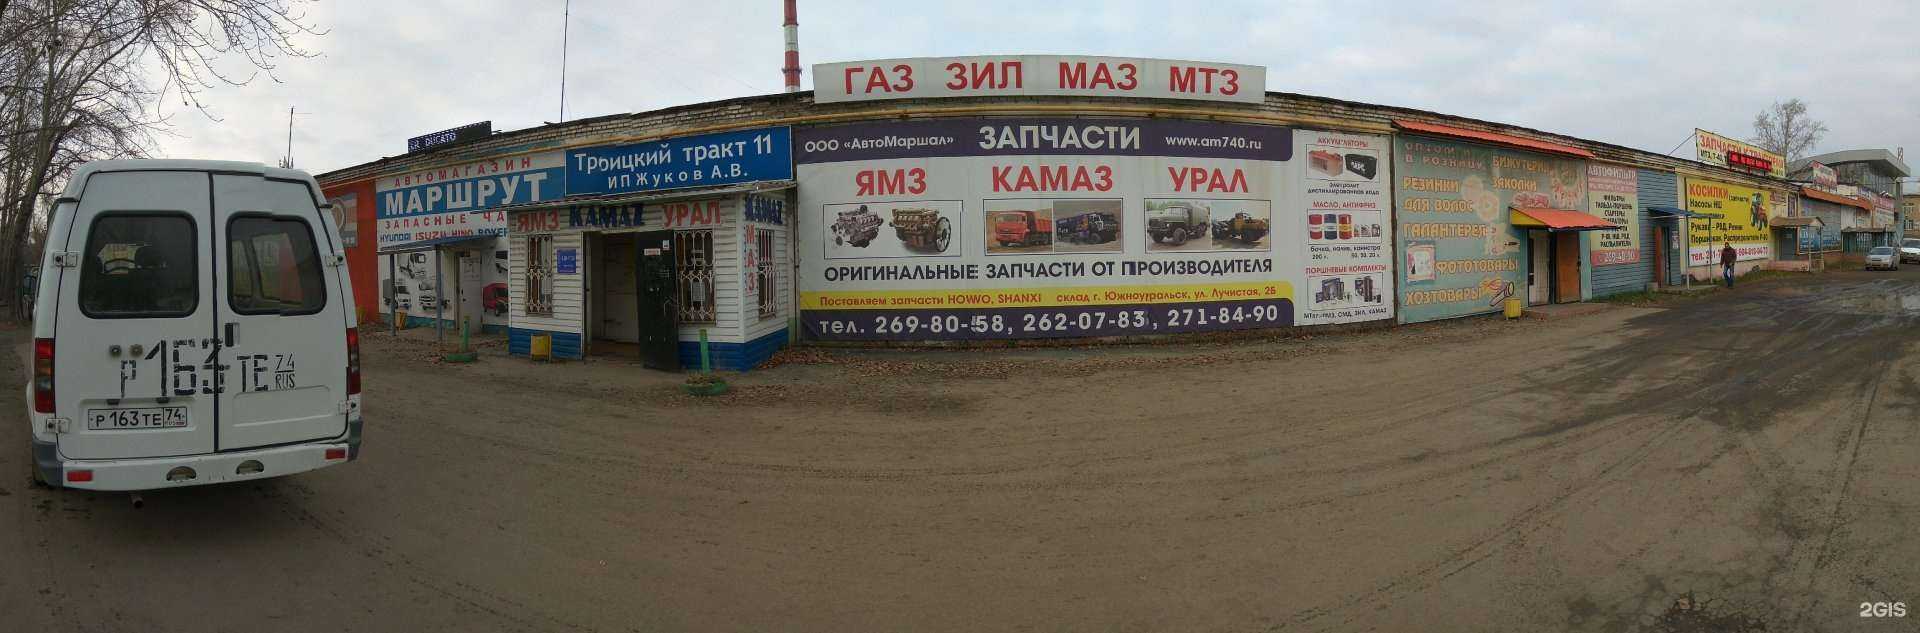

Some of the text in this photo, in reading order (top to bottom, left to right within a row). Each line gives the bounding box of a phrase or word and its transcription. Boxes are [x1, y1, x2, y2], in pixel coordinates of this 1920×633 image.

[844, 61, 1240, 96] ГАЗ ЗИЛ МАЗ МТЗ
[804, 125, 1262, 152] ООО «АвтоМаршал» ЗАПЧАСТИ www.am740.ru
[575, 134, 772, 174] Троицкий тракт 11
[394, 157, 531, 188] АВТОМАГАЗИН
[855, 165, 1249, 196] ЯМЗ КАМАЗ УРАЛ
[1403, 176, 1460, 193] РЕЗИНКИ
[1492, 176, 1537, 192] ЗАКОЛКИ
[384, 172, 548, 216] МАРШРУТ
[1689, 184, 1728, 198] КОСИЛКИ
[662, 199, 722, 228] УРАЛ
[1404, 198, 1430, 213] ДЛЯ
[385, 213, 466, 230] ЗАПАСНЫЕ
[517, 208, 560, 232] ЯМЗ
[824, 258, 1273, 282] ОРИГИНАЛЬНЫЕ ЗАПЧАСТИ ОТ ПРОИЗВОДИТЕЛЯ
[1435, 258, 1519, 275] ФОТОТОВАРЫ
[819, 294, 886, 308] Поставляем
[889, 295, 944, 306] запчасти
[997, 292, 1041, 305] SHANXI
[1056, 291, 1091, 304] склад
[1407, 287, 1482, 305] ХОЗТОВАРЫ
[820, 305, 1279, 337] тел. 269-80-58, 262-07-83, 271-84-90
